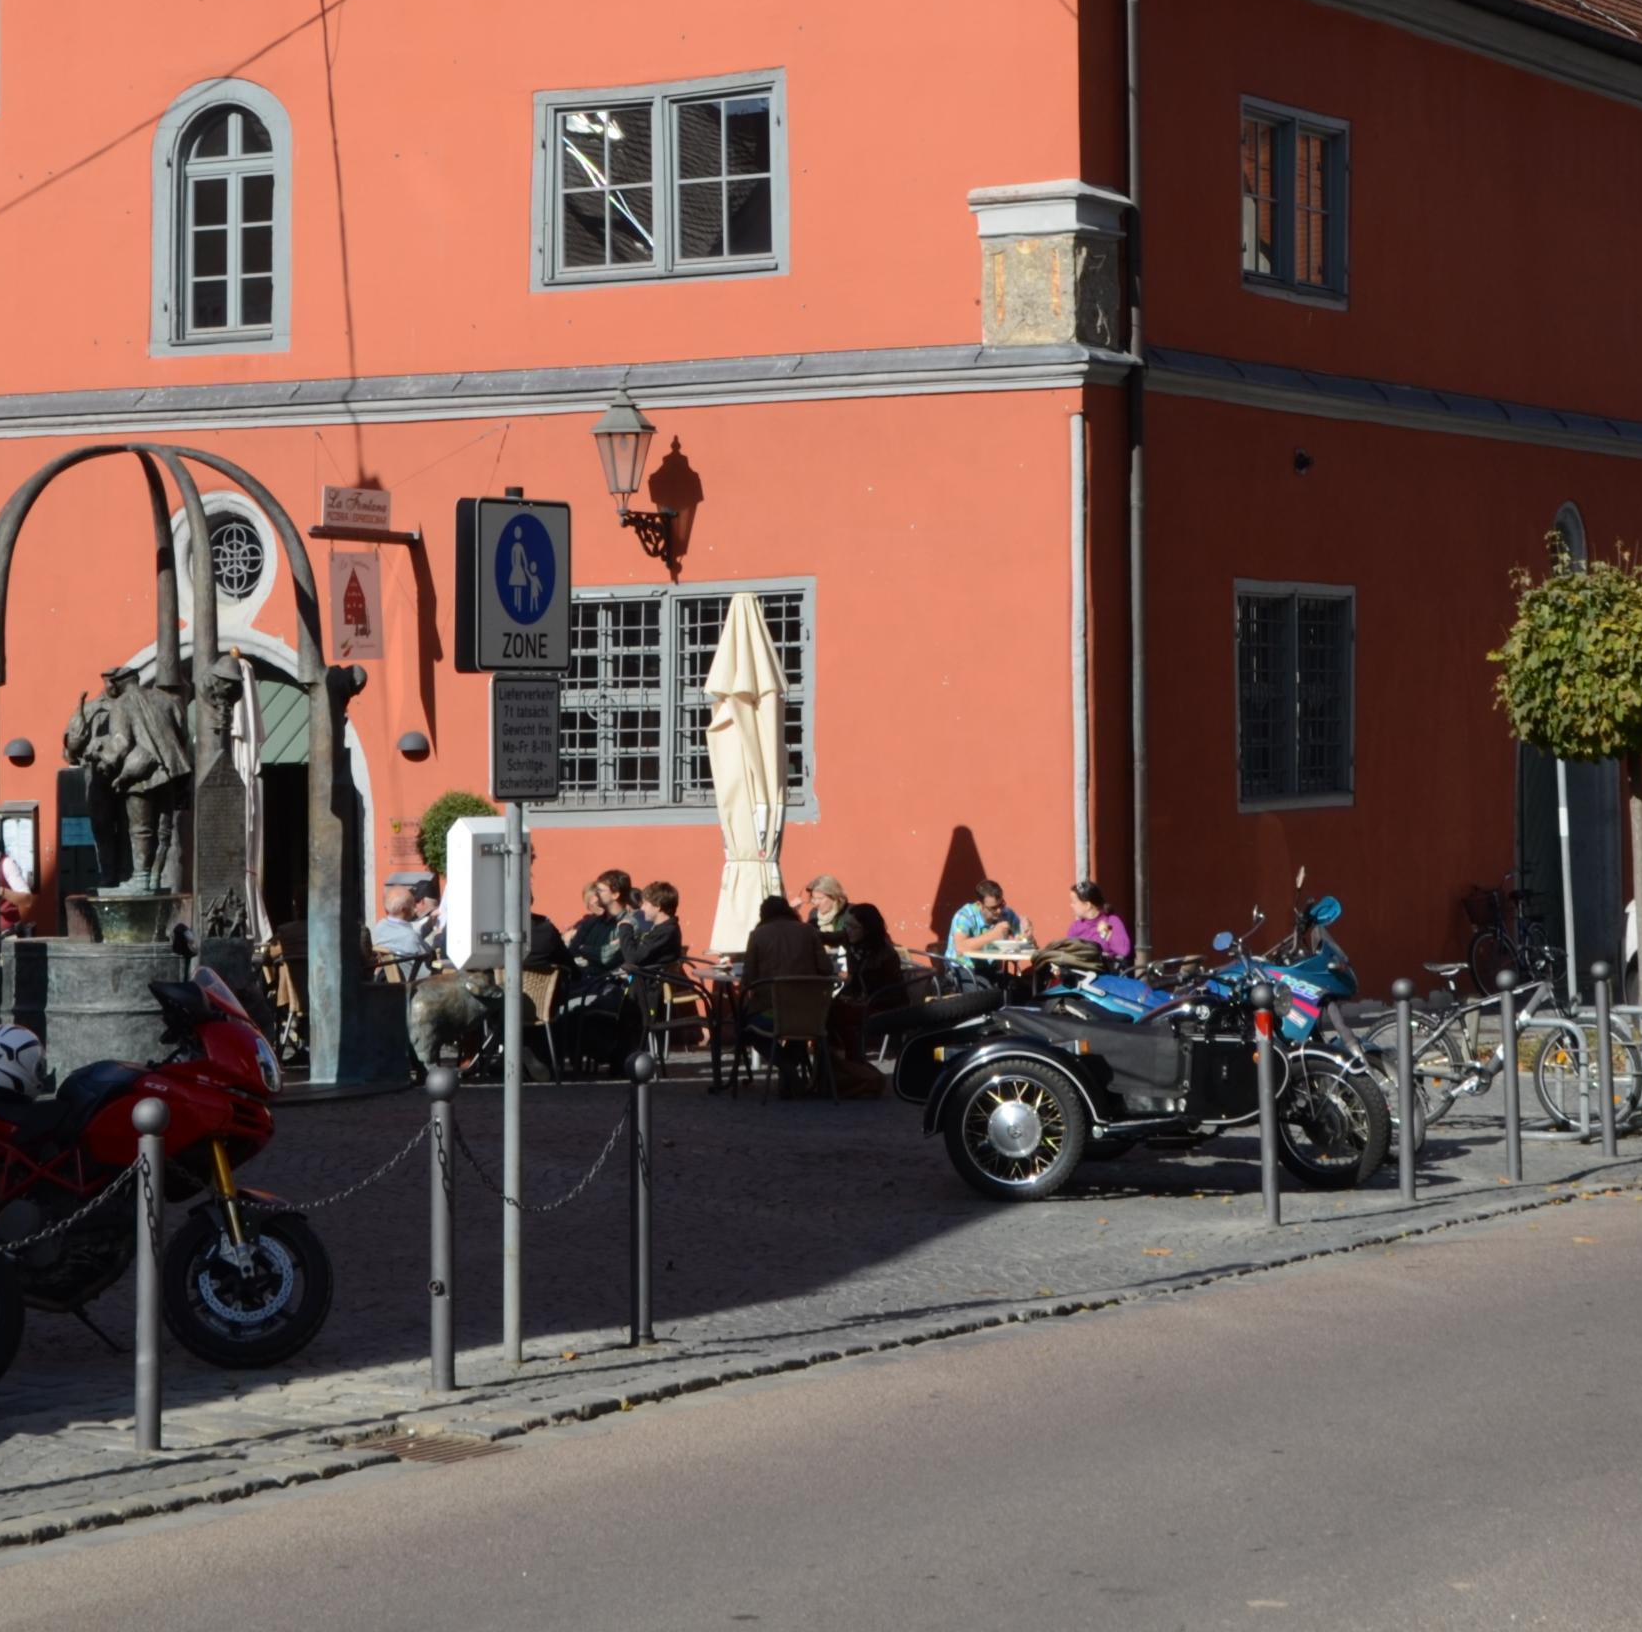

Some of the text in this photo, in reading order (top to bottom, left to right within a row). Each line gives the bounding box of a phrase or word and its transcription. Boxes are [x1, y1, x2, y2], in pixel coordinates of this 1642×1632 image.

[502, 632, 548, 659] ZONE
[499, 687, 555, 701] Lieferverkehr
[502, 723, 553, 737] Gewicht frei
[507, 759, 548, 774] Schrittge-
[500, 777, 554, 792] schwindigkeit
